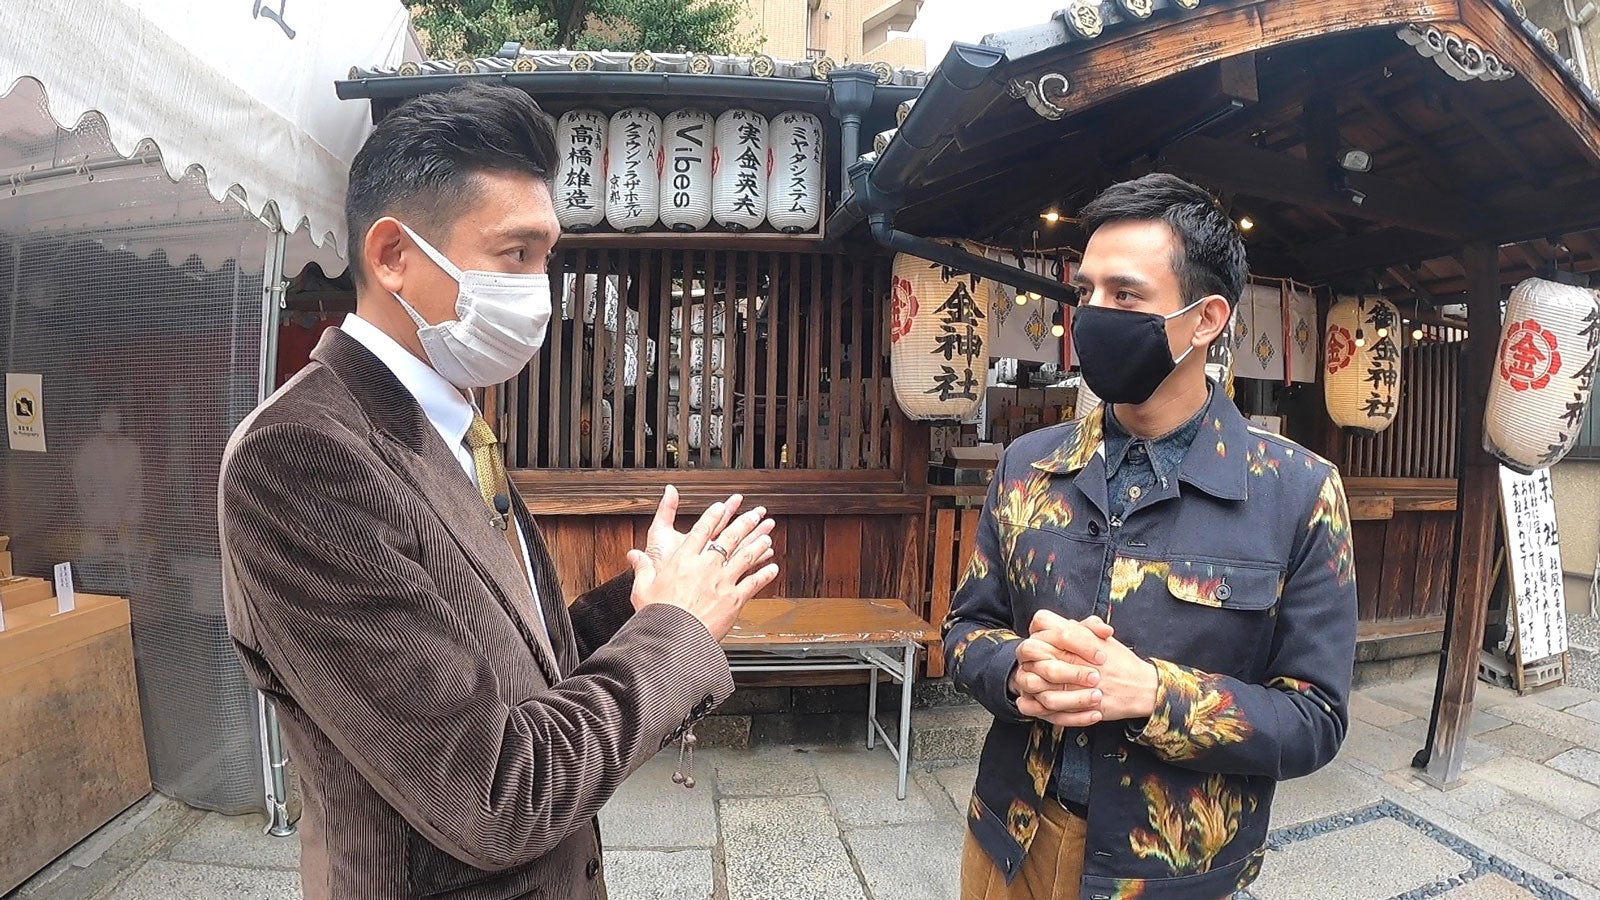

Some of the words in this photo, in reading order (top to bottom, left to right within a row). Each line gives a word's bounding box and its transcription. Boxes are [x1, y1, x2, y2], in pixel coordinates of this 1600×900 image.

[563, 124, 595, 210] 高橋雄造
[646, 125, 657, 162] ANA
[673, 124, 704, 209] Vibes
[731, 121, 762, 217] 実金英夫
[788, 126, 810, 214] ミヤタシステム
[609, 174, 621, 206] 京都
[1359, 300, 1399, 420] 御金神社
[1508, 331, 1546, 378] 金
[1539, 470, 1559, 546] 末社
